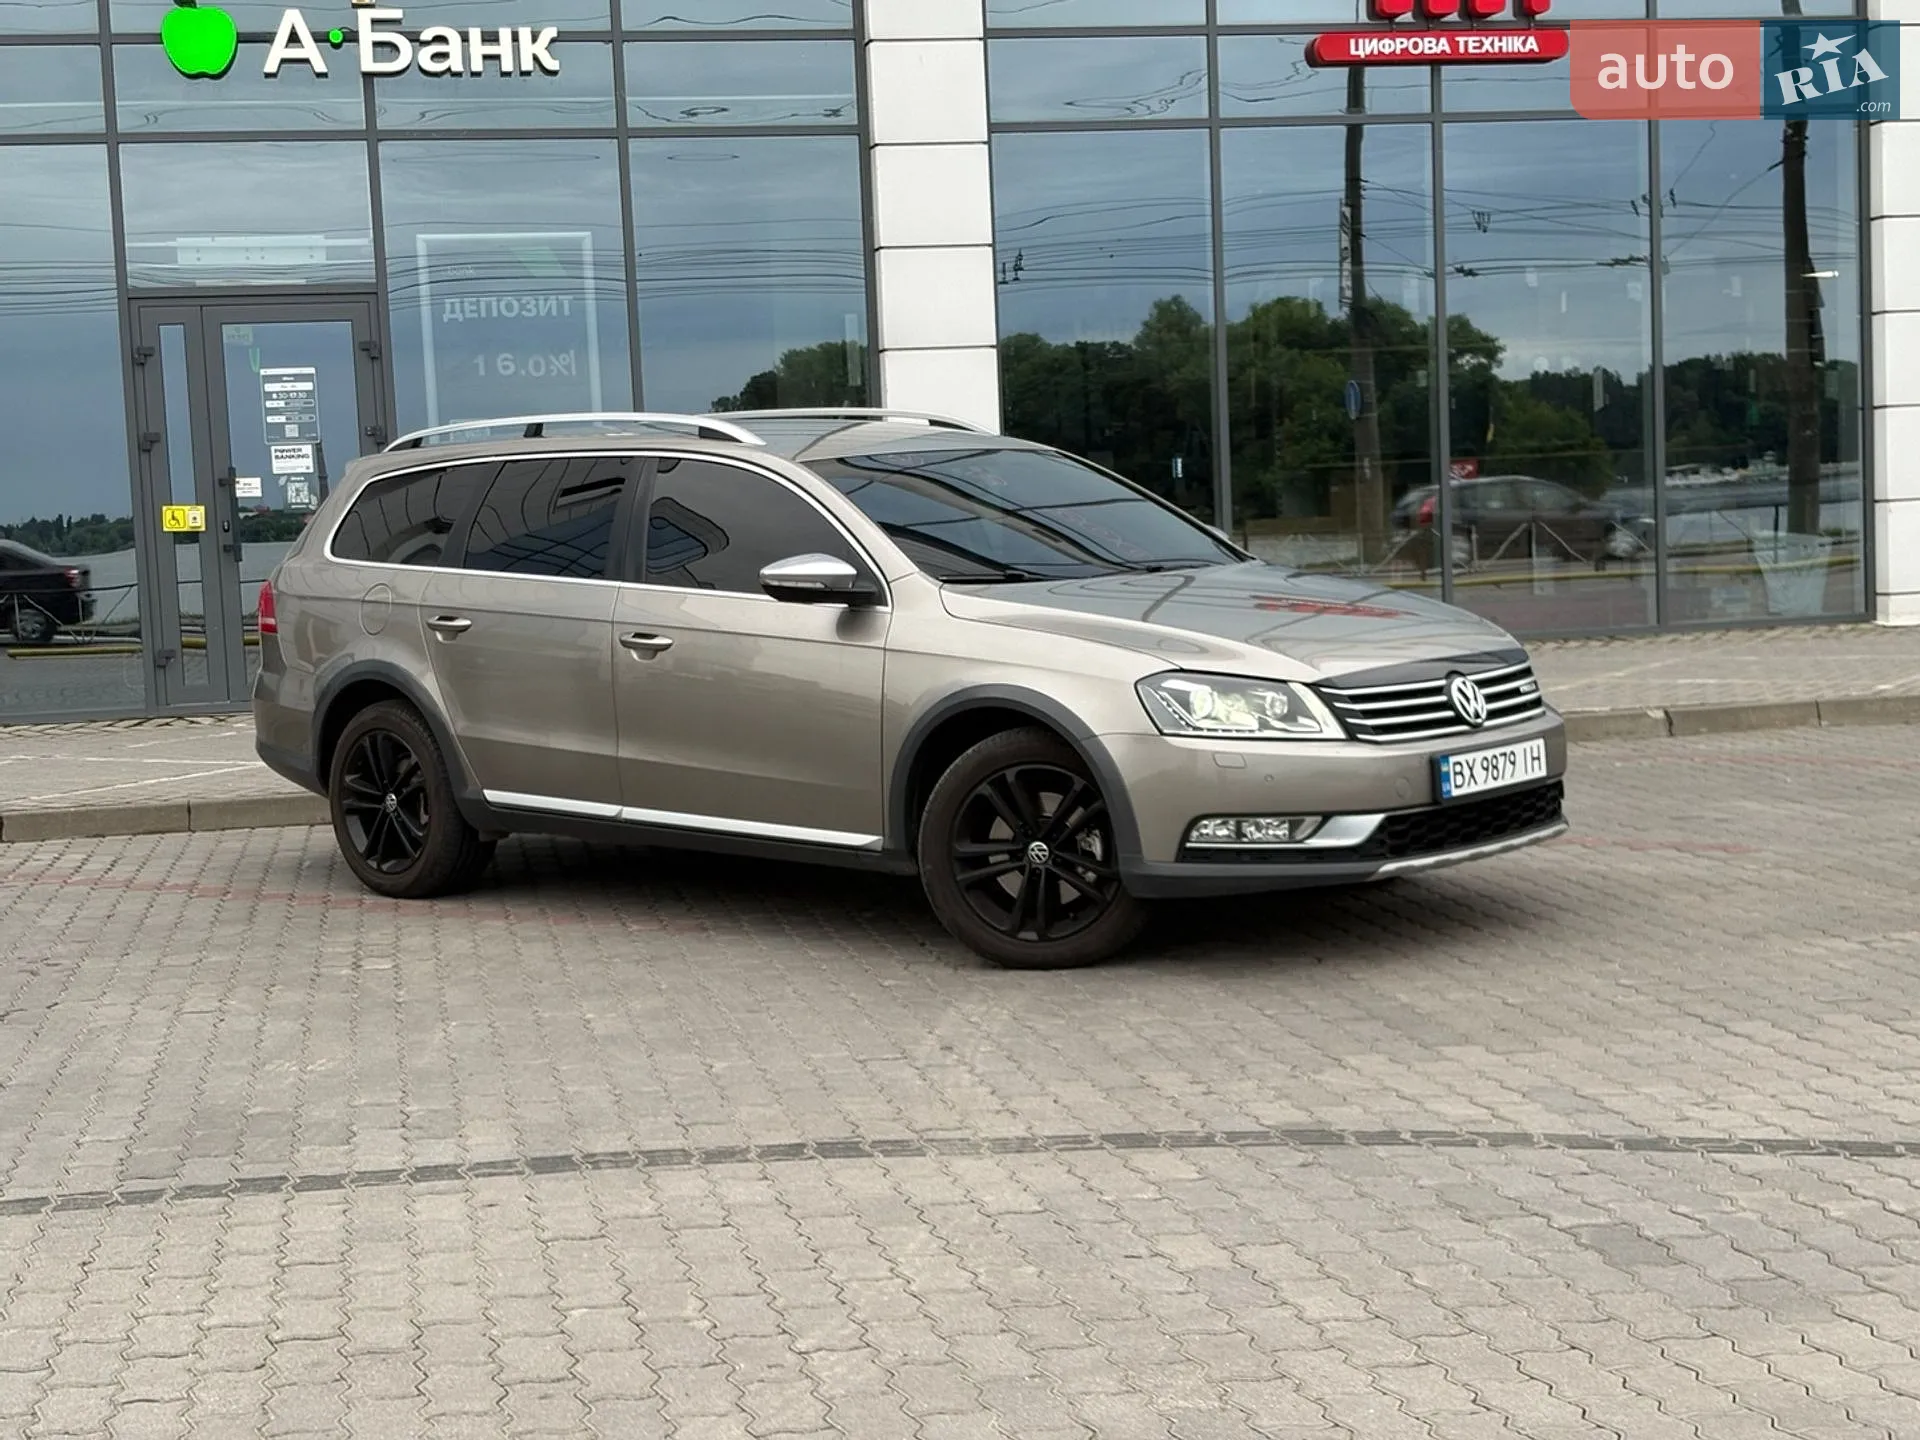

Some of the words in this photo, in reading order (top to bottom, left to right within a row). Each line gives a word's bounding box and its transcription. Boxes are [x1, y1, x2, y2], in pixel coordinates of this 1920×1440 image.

[1349, 37, 1451, 58] ЦИФРОВА
[1455, 35, 1539, 54] ТЕХНІКА
[443, 296, 574, 323] ДЕПОЗИТ
[1481, 751, 1517, 785] 9879
